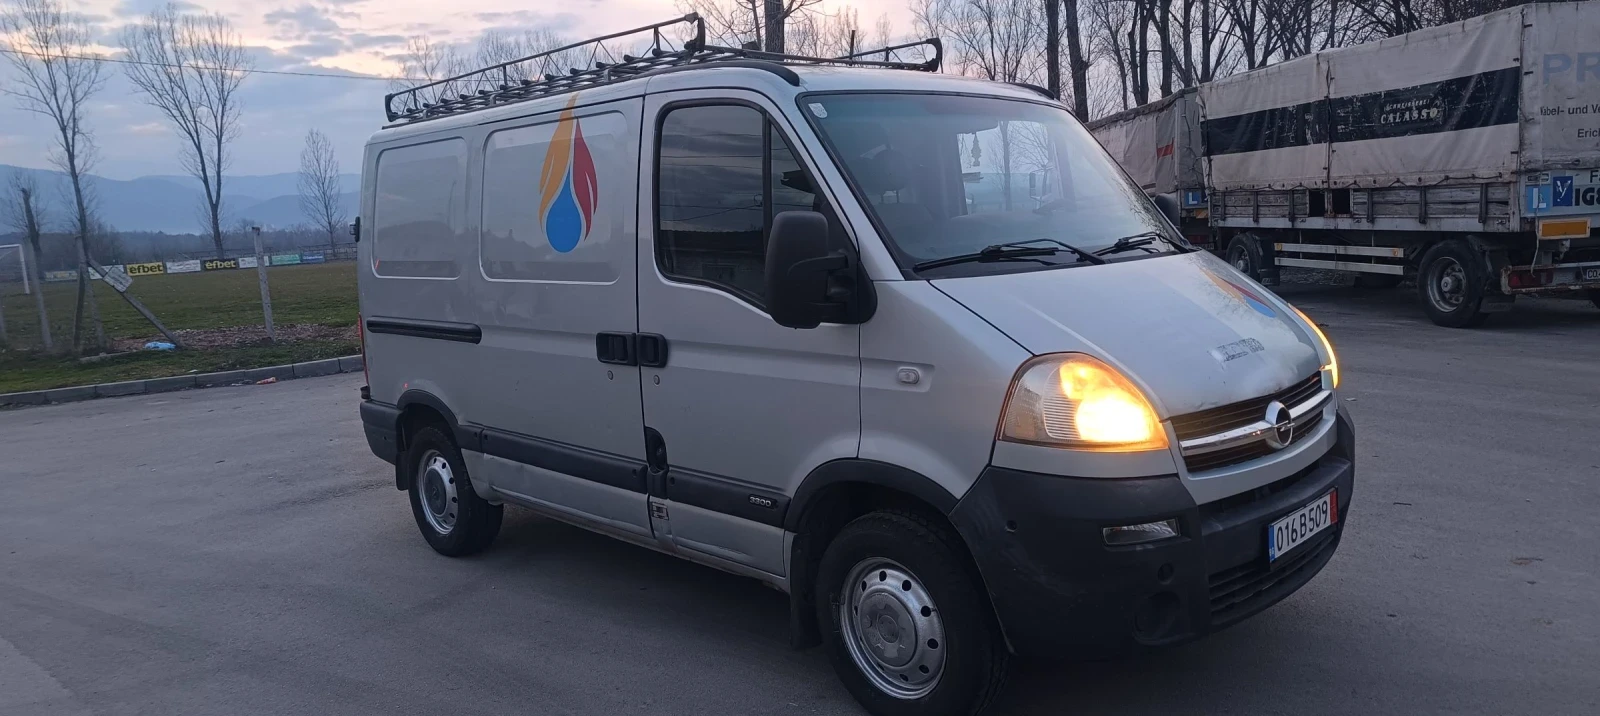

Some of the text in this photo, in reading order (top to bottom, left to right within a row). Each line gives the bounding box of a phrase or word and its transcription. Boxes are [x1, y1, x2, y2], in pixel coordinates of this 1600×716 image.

[1568, 104, 1588, 115] und
[1577, 128, 1600, 138] Eric
[1188, 192, 1198, 205] L
[129, 264, 163, 274] efbet
[205, 260, 236, 270] efbet
[750, 496, 771, 507] 3300
